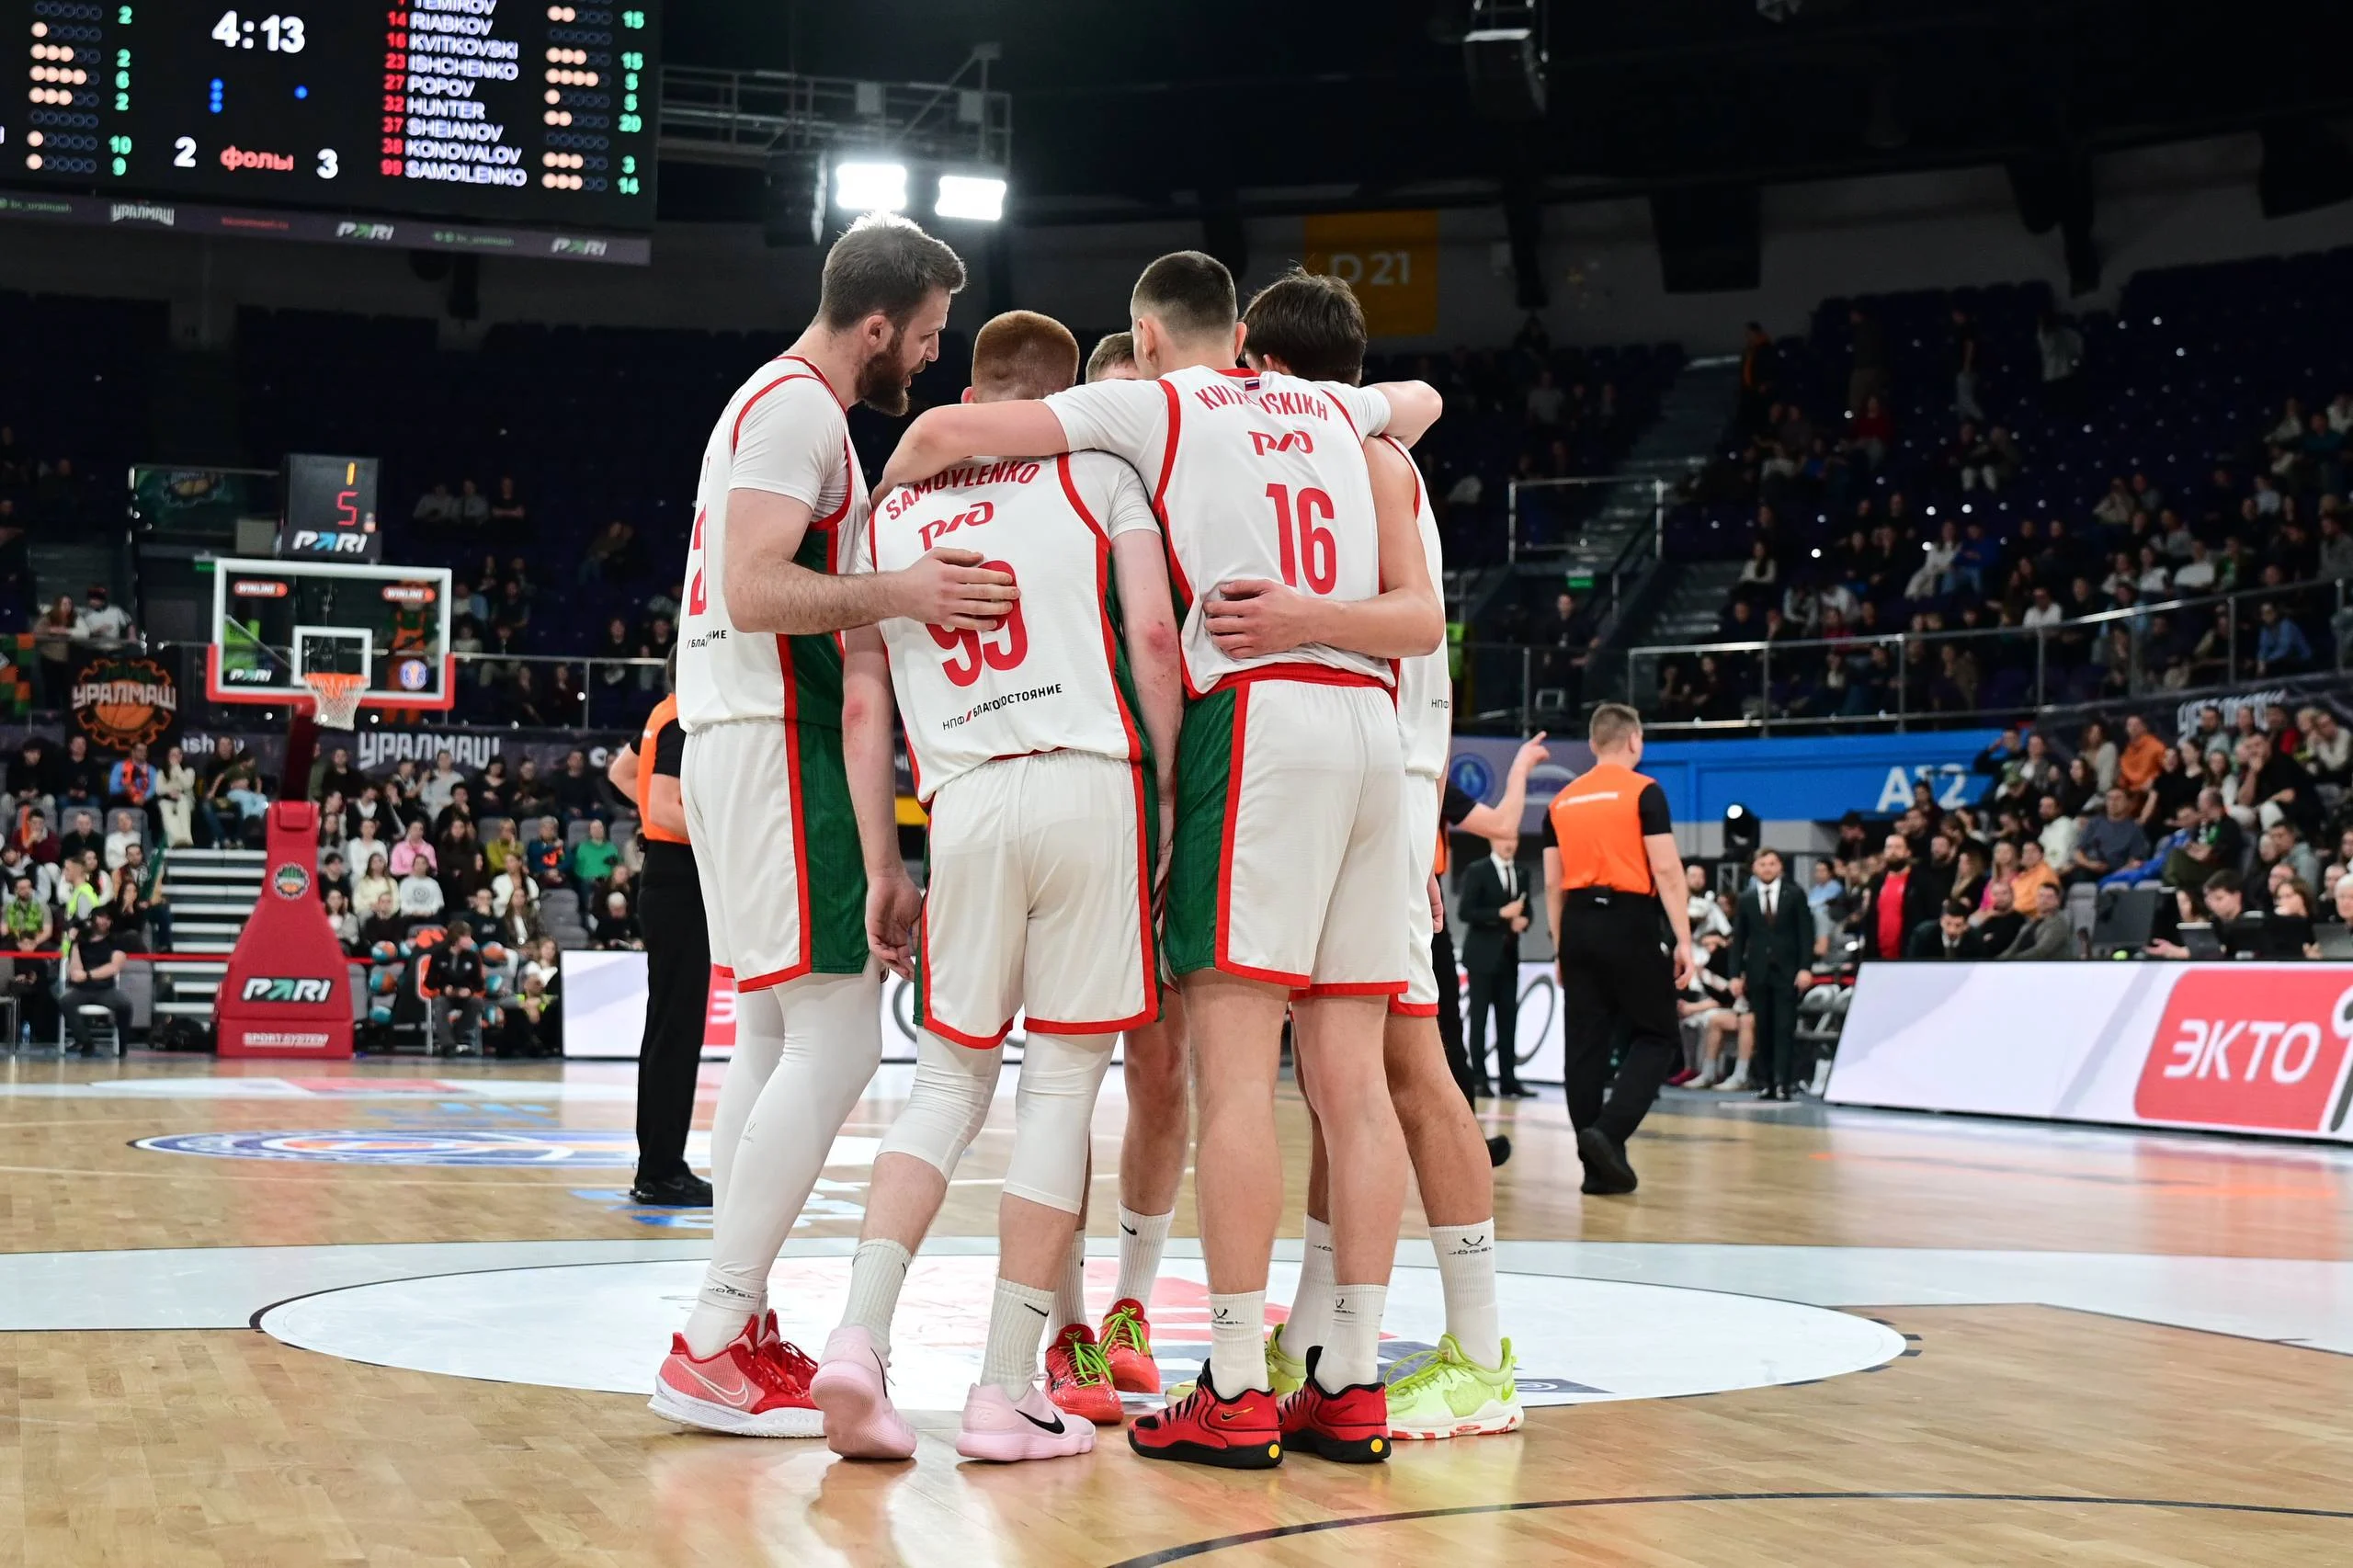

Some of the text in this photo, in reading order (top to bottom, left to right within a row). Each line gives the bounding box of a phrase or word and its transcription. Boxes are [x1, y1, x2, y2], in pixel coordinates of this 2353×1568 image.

[118, 6, 132, 24] 2
[388, 11, 407, 27] 14
[409, 12, 494, 37] RIABKOV
[211, 10, 306, 54] 4:13
[117, 49, 131, 67] 2
[408, 33, 519, 60] KVITKOVSKI
[385, 52, 405, 70] 23
[408, 54, 519, 81] ISHCHENKO
[383, 74, 405, 90] 27
[407, 74, 475, 97] POPOV
[115, 92, 129, 111] 2
[382, 95, 404, 112] 32
[406, 97, 485, 119] HUNTER
[382, 113, 642, 142] 37 SHEIANOV 20
[108, 135, 131, 154] 10
[174, 137, 338, 178] 2 фолы 3
[405, 139, 522, 165] KONOVALOV
[621, 155, 635, 174] 3
[112, 157, 126, 176] 9
[404, 159, 528, 187] SAMOILENKO
[335, 222, 394, 241] PARI
[885, 460, 1040, 521] SAMOYLENKO
[336, 491, 358, 526] 5
[291, 529, 368, 553] PARI
[1265, 483, 1337, 596] 16
[71, 683, 177, 711] УРАЛМАШ
[242, 976, 332, 1003] PARI
